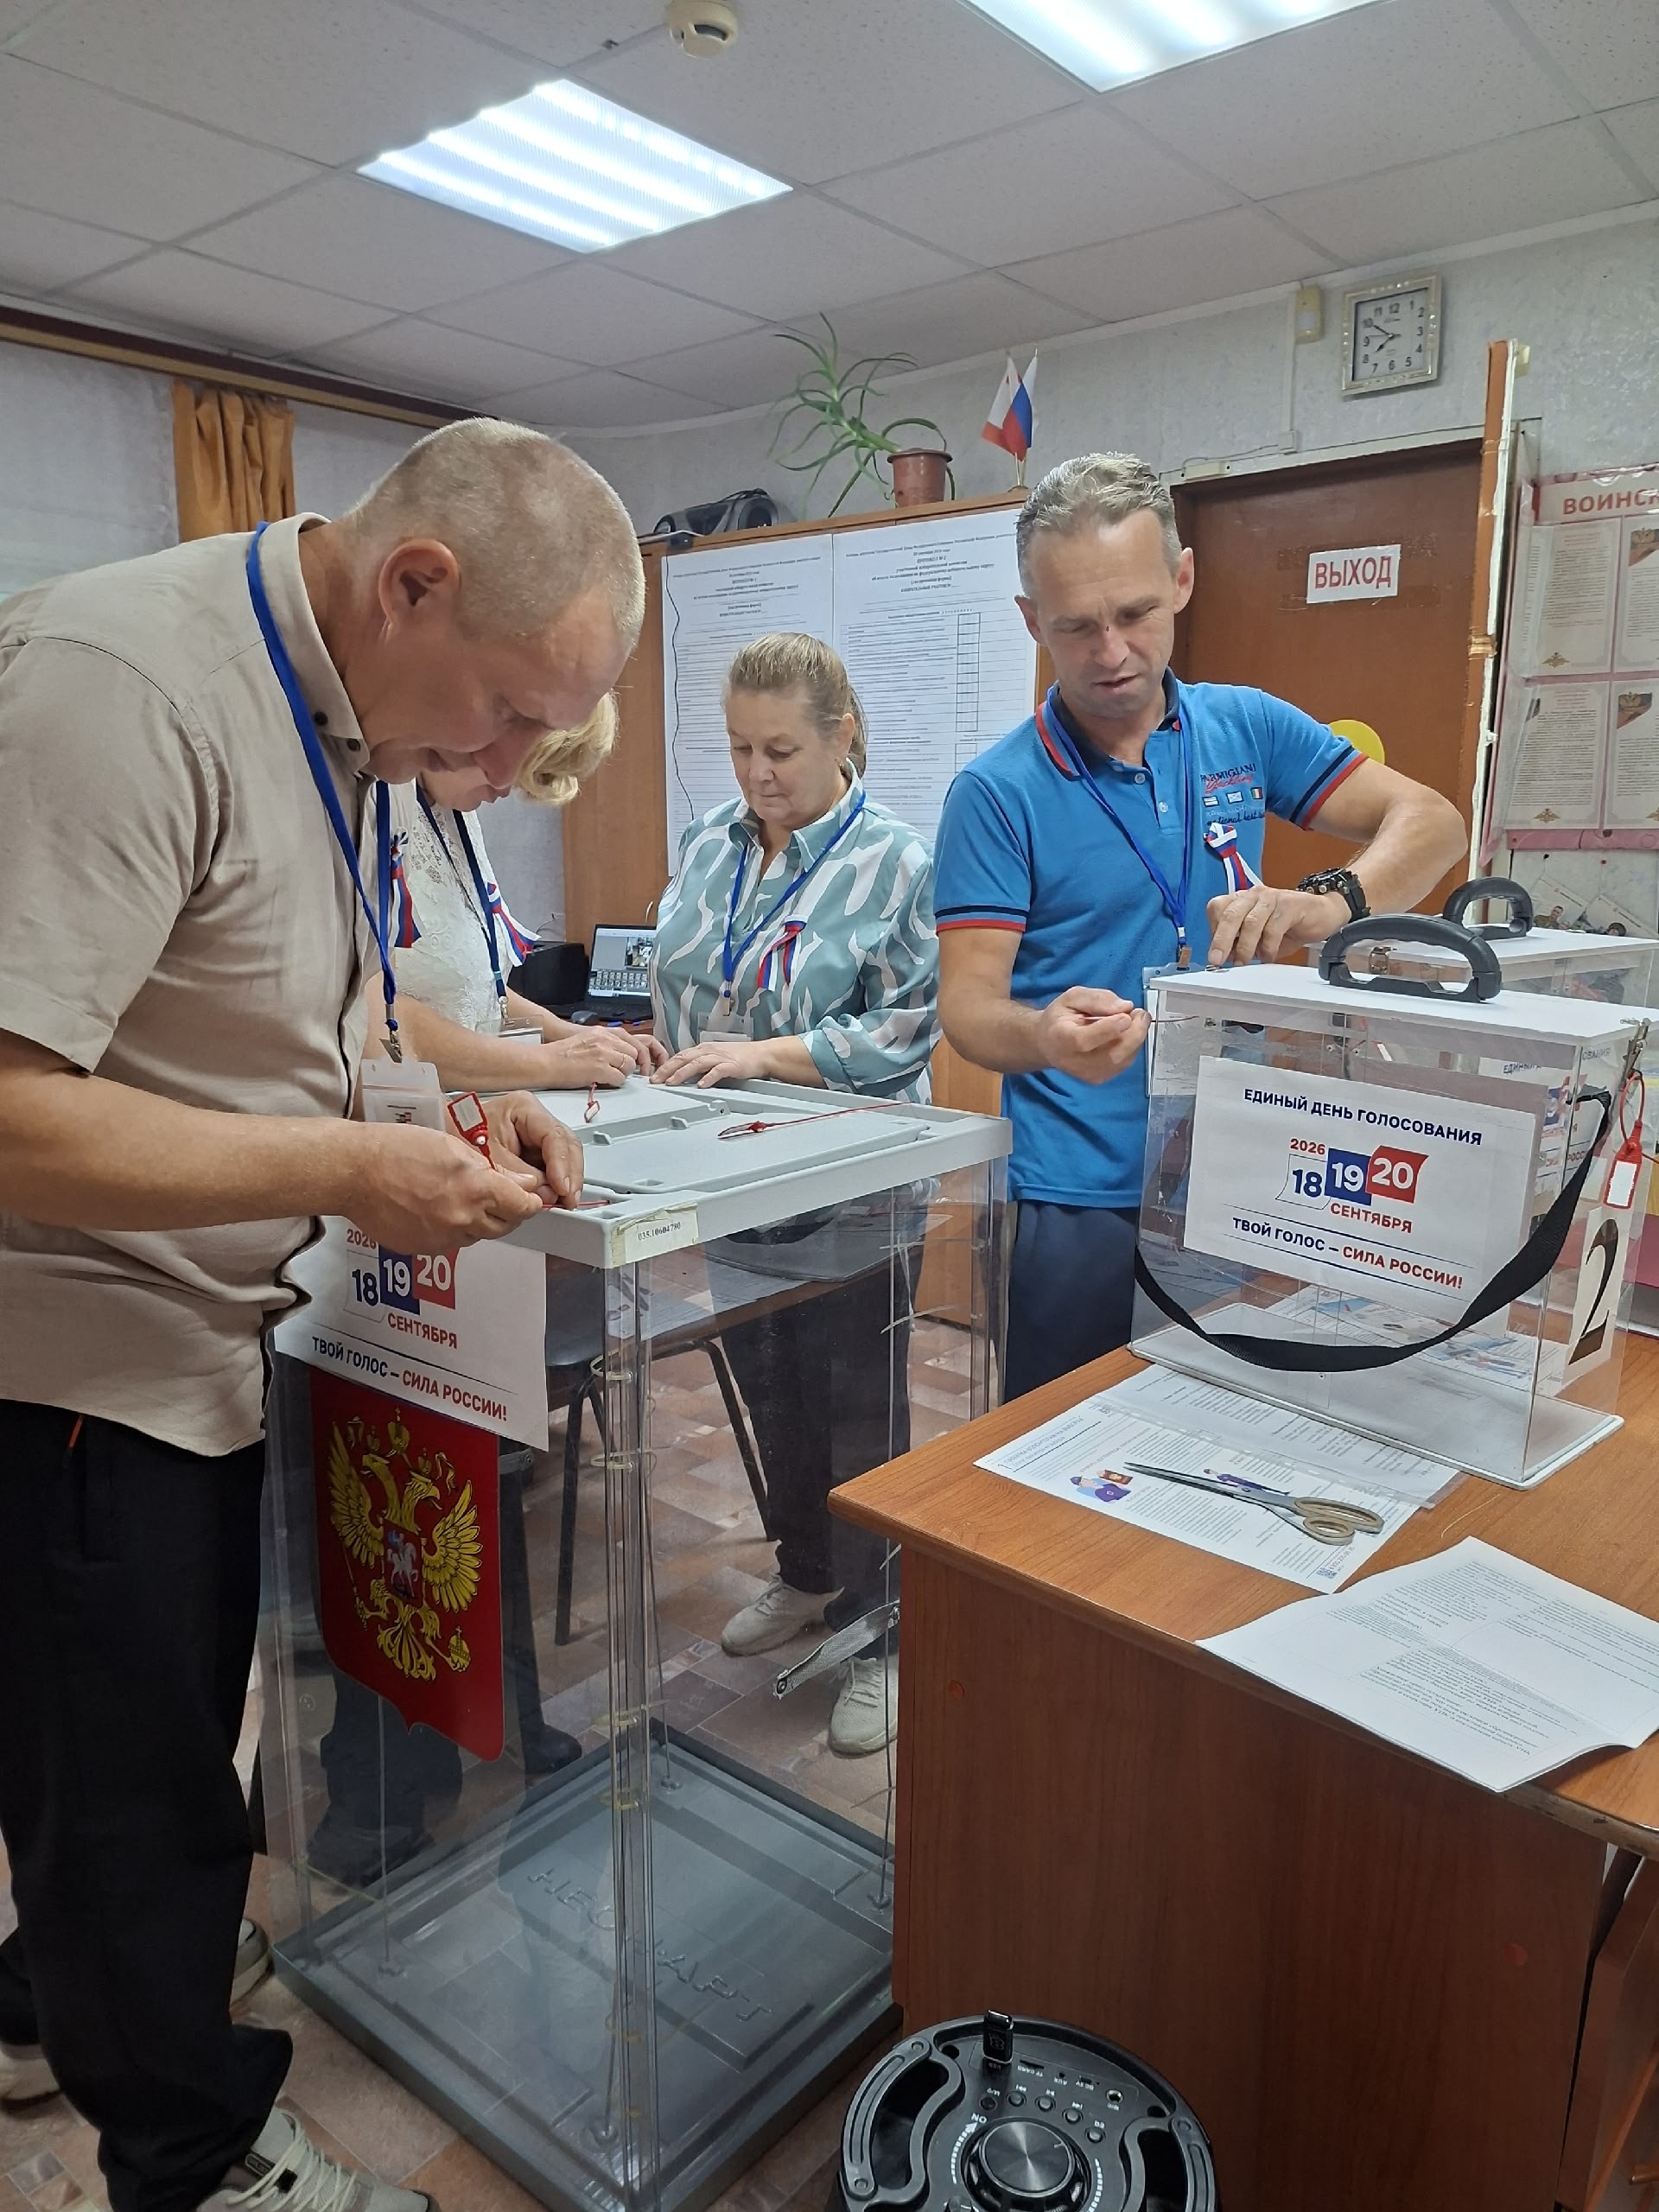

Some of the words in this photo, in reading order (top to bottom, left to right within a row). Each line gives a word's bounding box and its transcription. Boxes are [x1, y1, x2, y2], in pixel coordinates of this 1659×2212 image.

[1389, 302, 1400, 314] 12
[1410, 300, 1414, 309] 1
[1418, 307, 1425, 317] 2
[1417, 326, 1423, 336] 3
[1363, 336, 1370, 346] 9
[1415, 343, 1422, 353] 4
[1363, 353, 1369, 364] 8
[1389, 359, 1395, 370] 6
[1405, 356, 1412, 366] 5
[1372, 363, 1378, 373] 7
[1314, 556, 1392, 589] ВЫХОД
[1200, 763, 1257, 783] PARMIGIANI
[1244, 1089, 1307, 1112] ЕДИНЫЙ
[1311, 1102, 1353, 1120] ДЕНЬ
[1357, 1109, 1483, 1146] ГОЛОСОВАНИЯ
[1290, 1138, 1325, 1155] 2026
[1292, 1168, 1323, 1198] 18
[1332, 1162, 1363, 1192] 19
[1371, 1158, 1414, 1189] 20
[1331, 1202, 1413, 1234] СЕНТЯБРЯ
[346, 1228, 377, 1249] 2026
[1232, 1217, 1271, 1237] ТВОЙ
[1274, 1227, 1325, 1251] ГОЛОС
[1343, 1246, 1385, 1268] СИЛА
[1389, 1259, 1463, 1289] РОССИИ!
[352, 1268, 379, 1306] 18
[383, 1258, 410, 1297] 19
[416, 1255, 451, 1291] 20
[1567, 1218, 1619, 1365] 2
[388, 1313, 457, 1350] СЕНТЯБРЯ
[312, 1336, 343, 1361] ТВОЙ
[346, 1350, 388, 1378] ГОЛОС
[403, 1370, 439, 1397] СИЛА
[442, 1383, 507, 1421] РОССИИ!
[1054, 2076, 1067, 2086] AUX
[970, 2111, 988, 2125] ON
